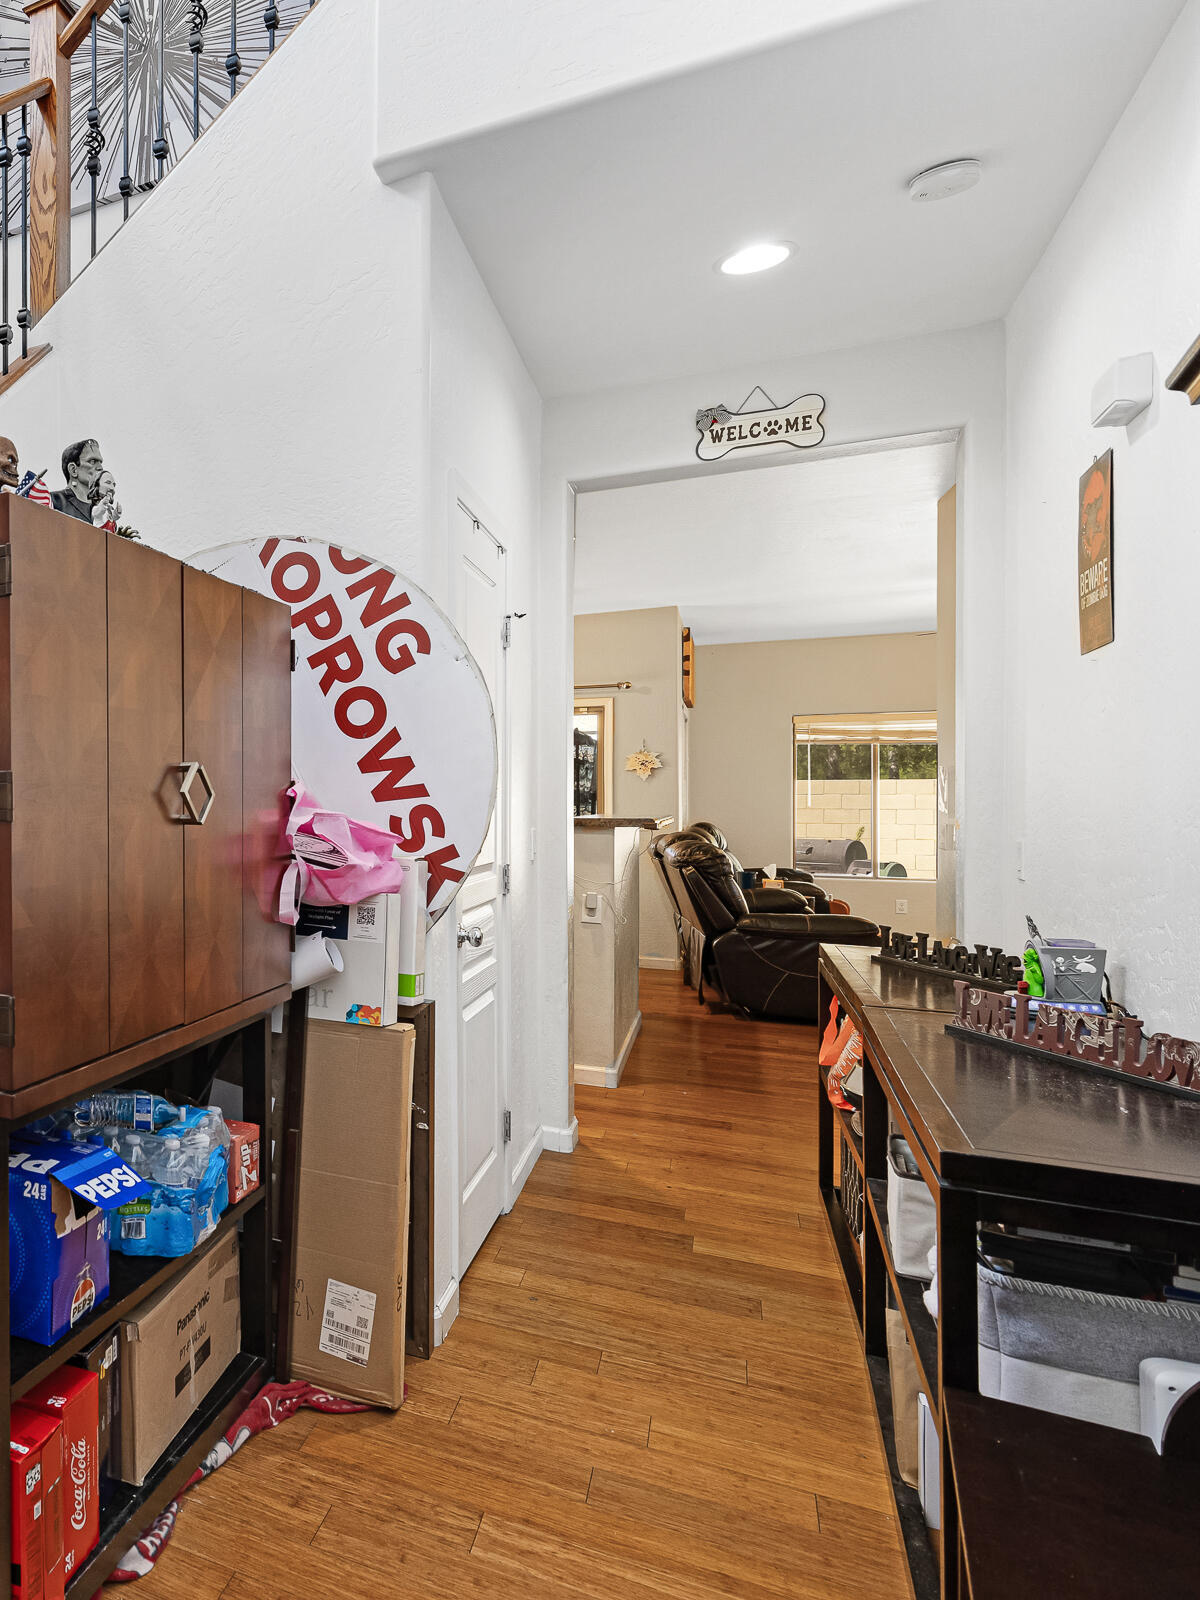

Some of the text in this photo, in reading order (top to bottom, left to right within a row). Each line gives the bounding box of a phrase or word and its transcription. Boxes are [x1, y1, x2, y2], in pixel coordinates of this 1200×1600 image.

[709, 414, 813, 443] WELCME
[1080, 557, 1108, 597] BEWARE
[1121, 1017, 1200, 1092] LOV
[23, 1181, 39, 1199] 24
[74, 1164, 142, 1203] PEPSI
[72, 1292, 93, 1318] PEPSI
[176, 1290, 210, 1336] Panasonic
[70, 1437, 87, 1531] Coca-Cola
